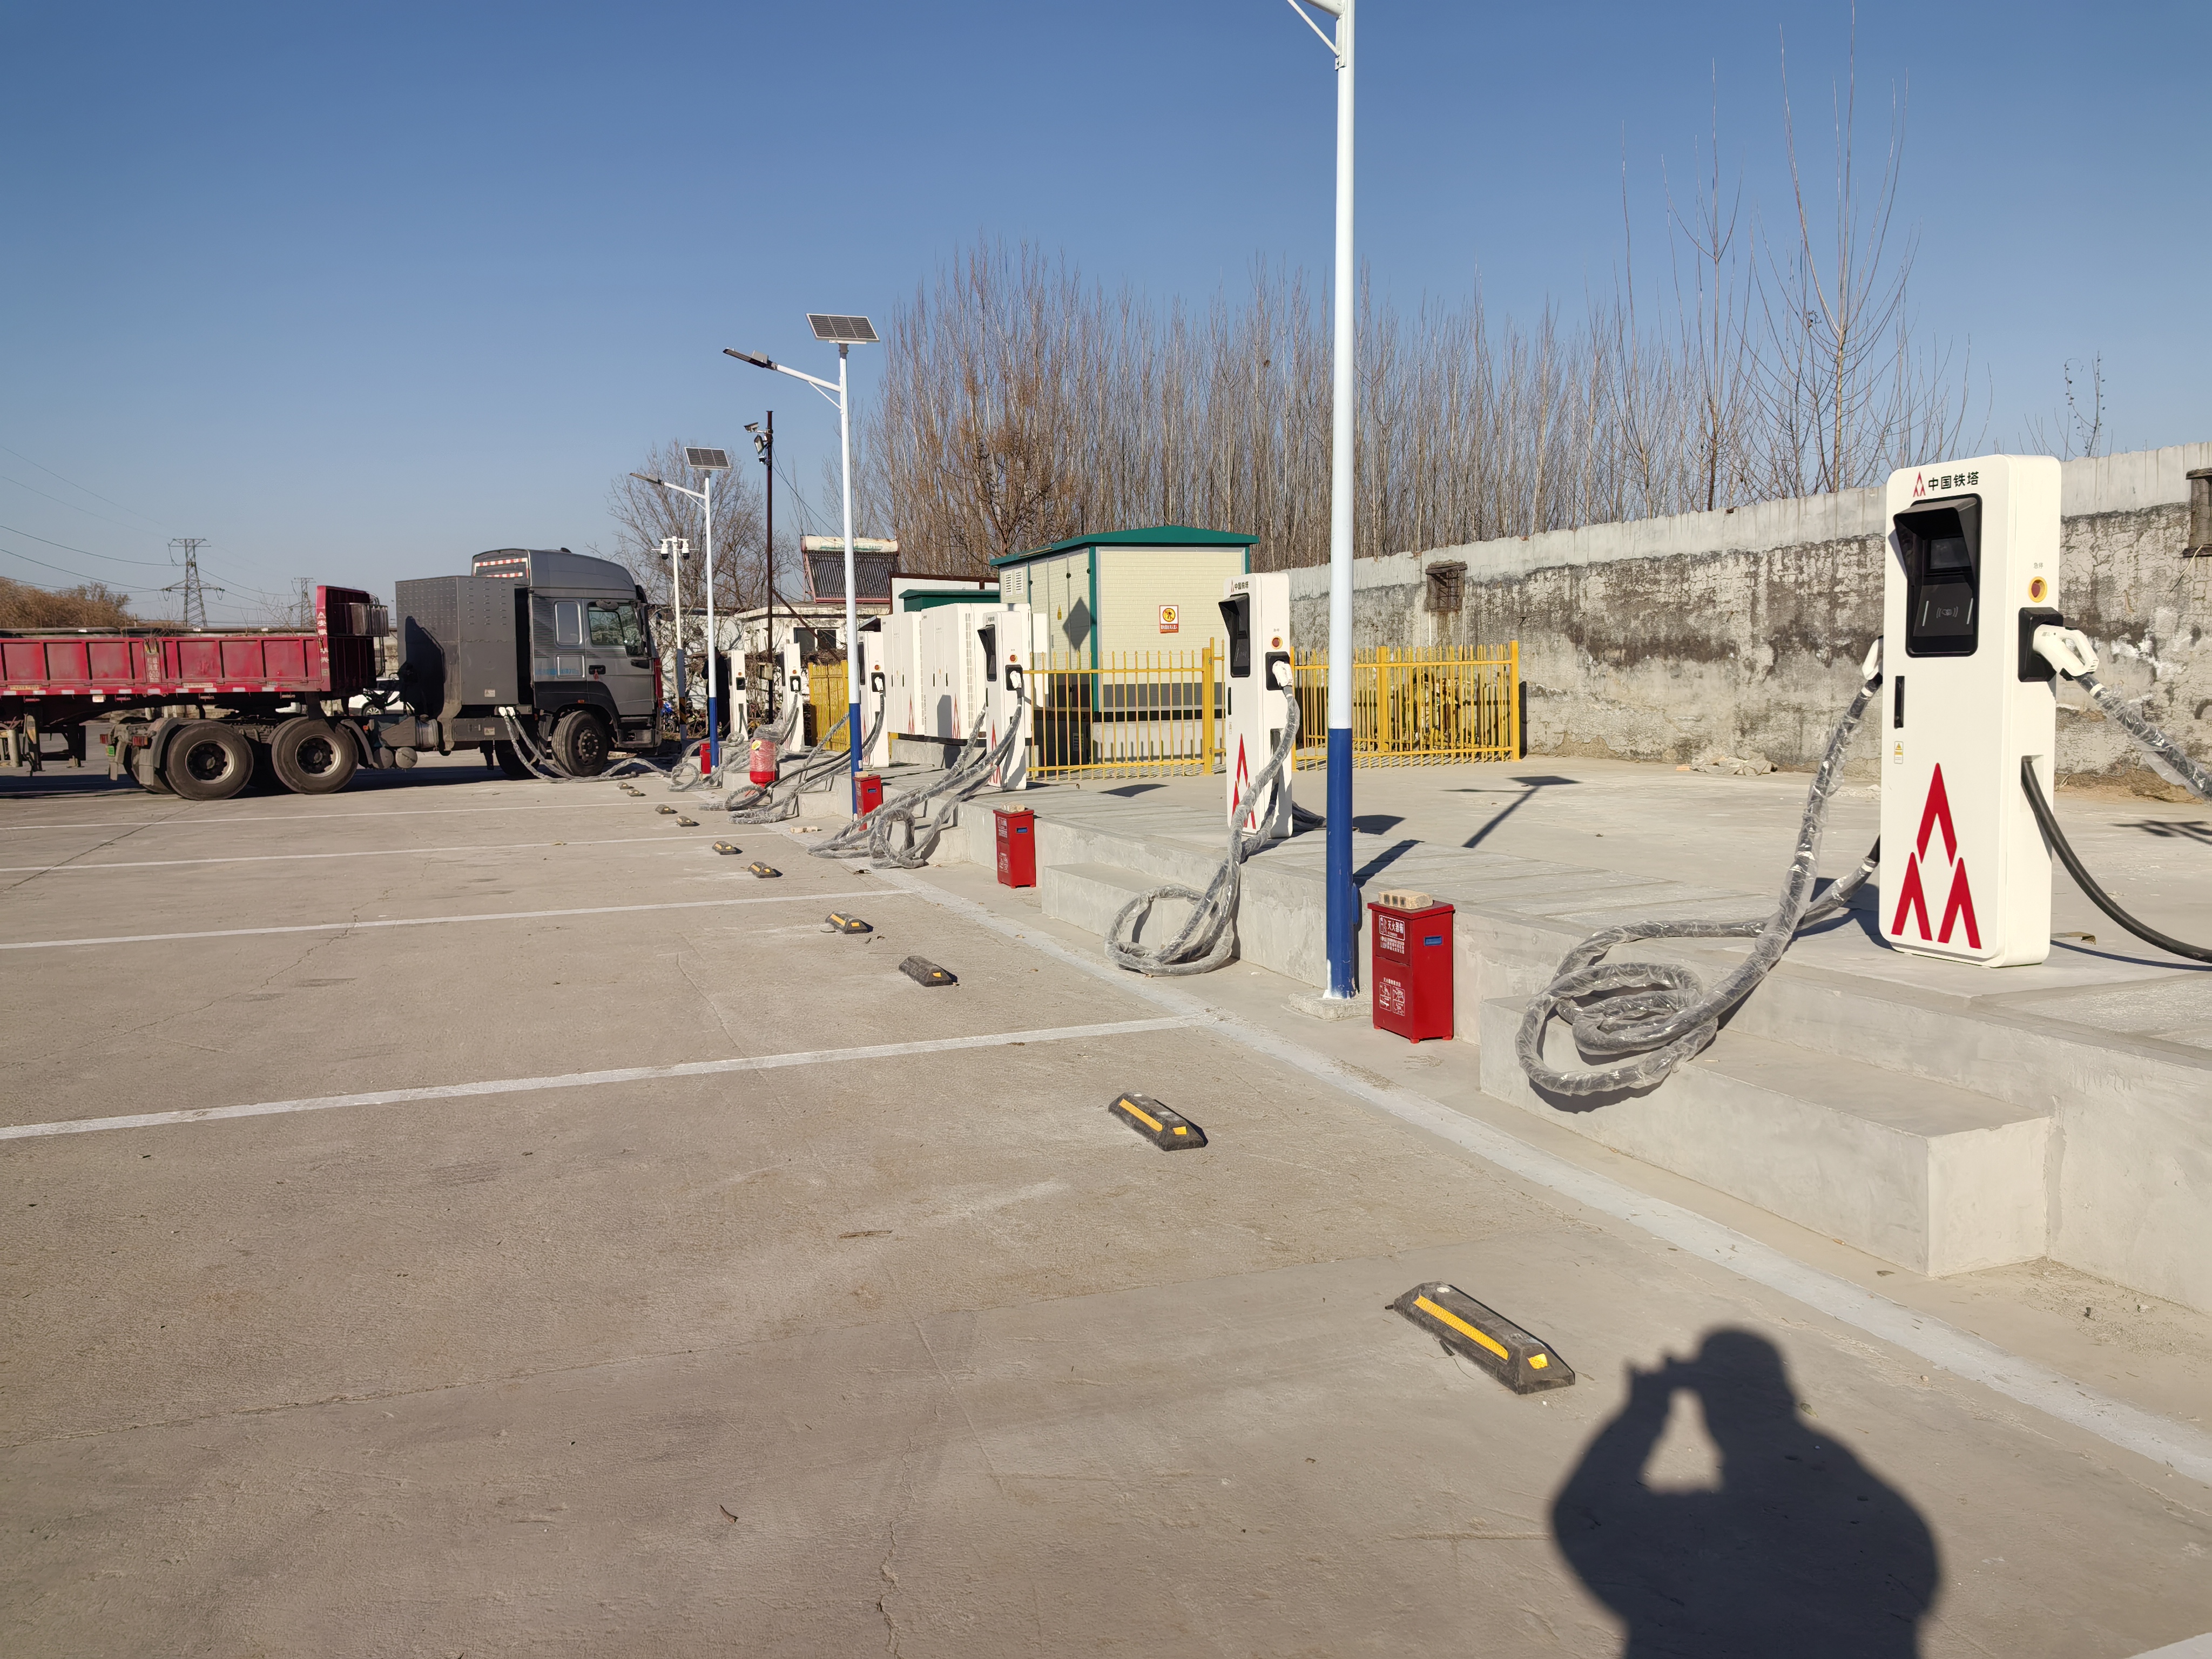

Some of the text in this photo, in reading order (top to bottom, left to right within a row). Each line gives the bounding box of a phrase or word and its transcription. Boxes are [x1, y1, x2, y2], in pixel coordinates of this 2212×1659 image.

[1928, 471, 1979, 491] 中国铁塔
[1234, 581, 1249, 590] 中国铁塔
[1387, 920, 1404, 934] 灭火器箱
